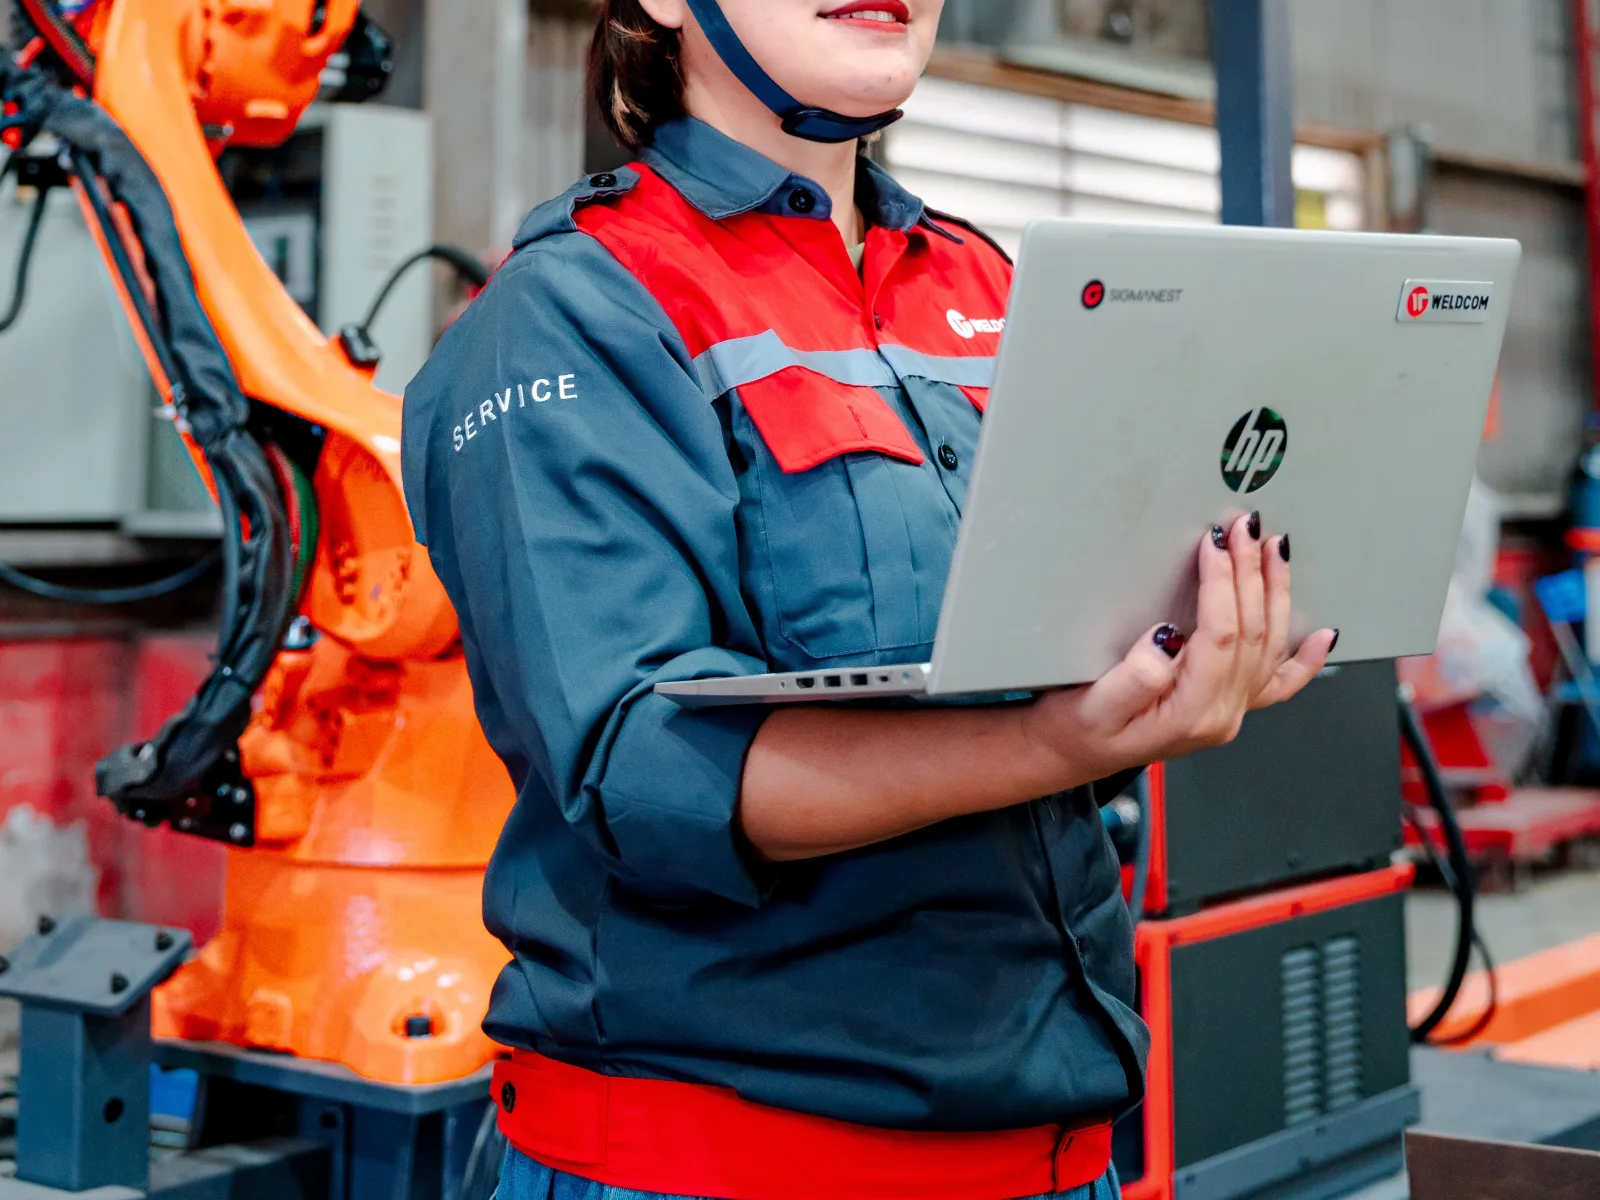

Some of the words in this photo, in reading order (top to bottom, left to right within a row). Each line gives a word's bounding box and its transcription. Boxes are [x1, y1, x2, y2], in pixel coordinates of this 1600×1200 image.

[1431, 294, 1490, 310] WELDCOM
[453, 373, 578, 452] SERVICE
[1224, 406, 1285, 493] hp
